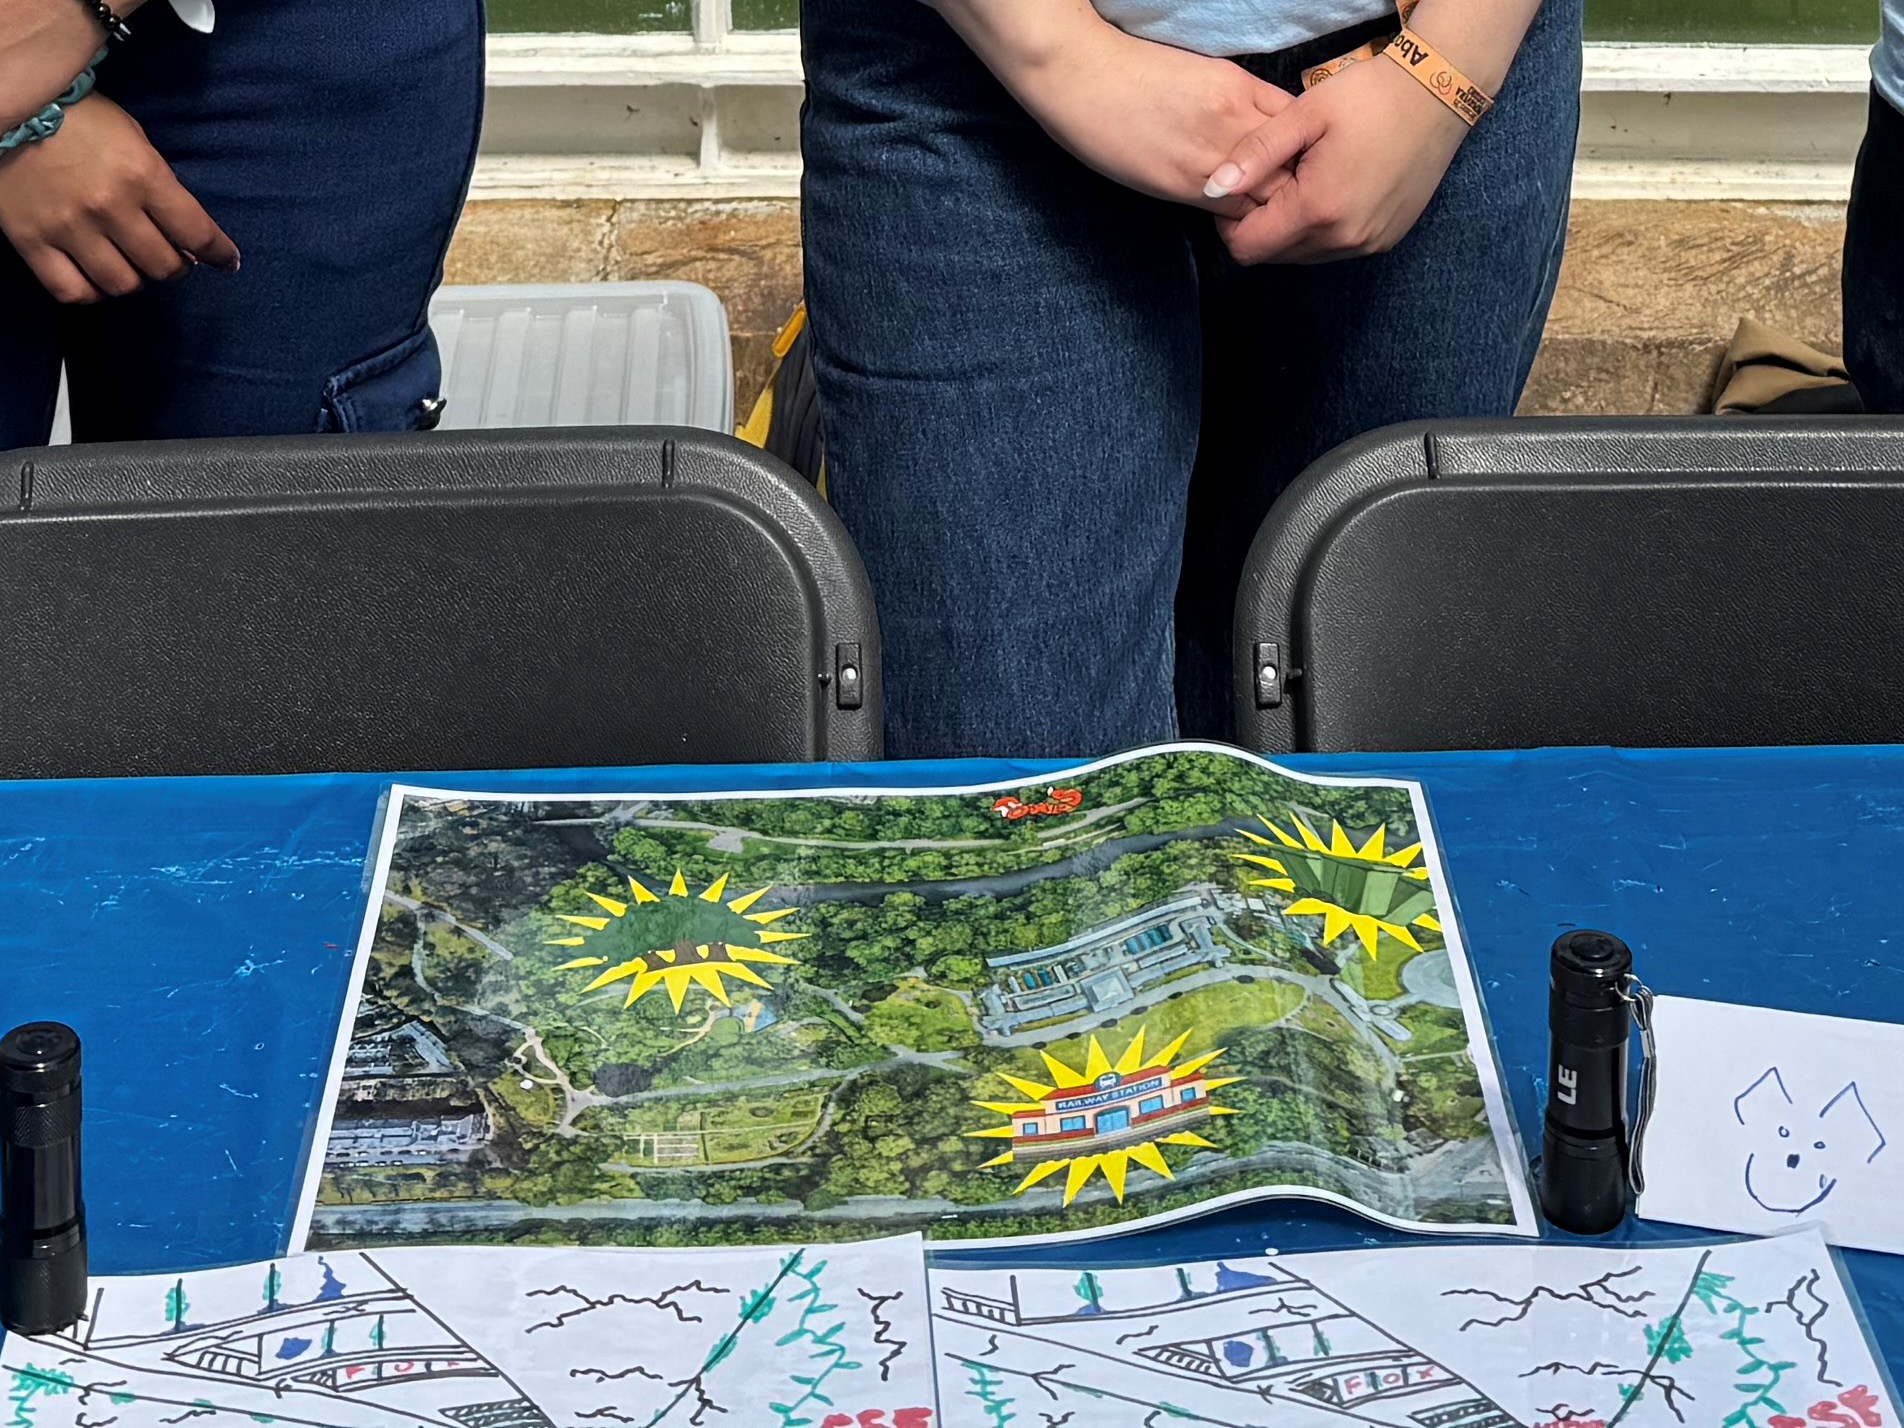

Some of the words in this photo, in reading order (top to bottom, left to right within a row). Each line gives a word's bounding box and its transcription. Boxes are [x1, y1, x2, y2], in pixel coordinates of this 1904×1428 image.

[1394, 35, 1429, 66] Abo
[1058, 1093, 1108, 1109] RAILWAY
[1111, 1079, 1160, 1099] STATION
[1557, 1064, 1578, 1106] LE
